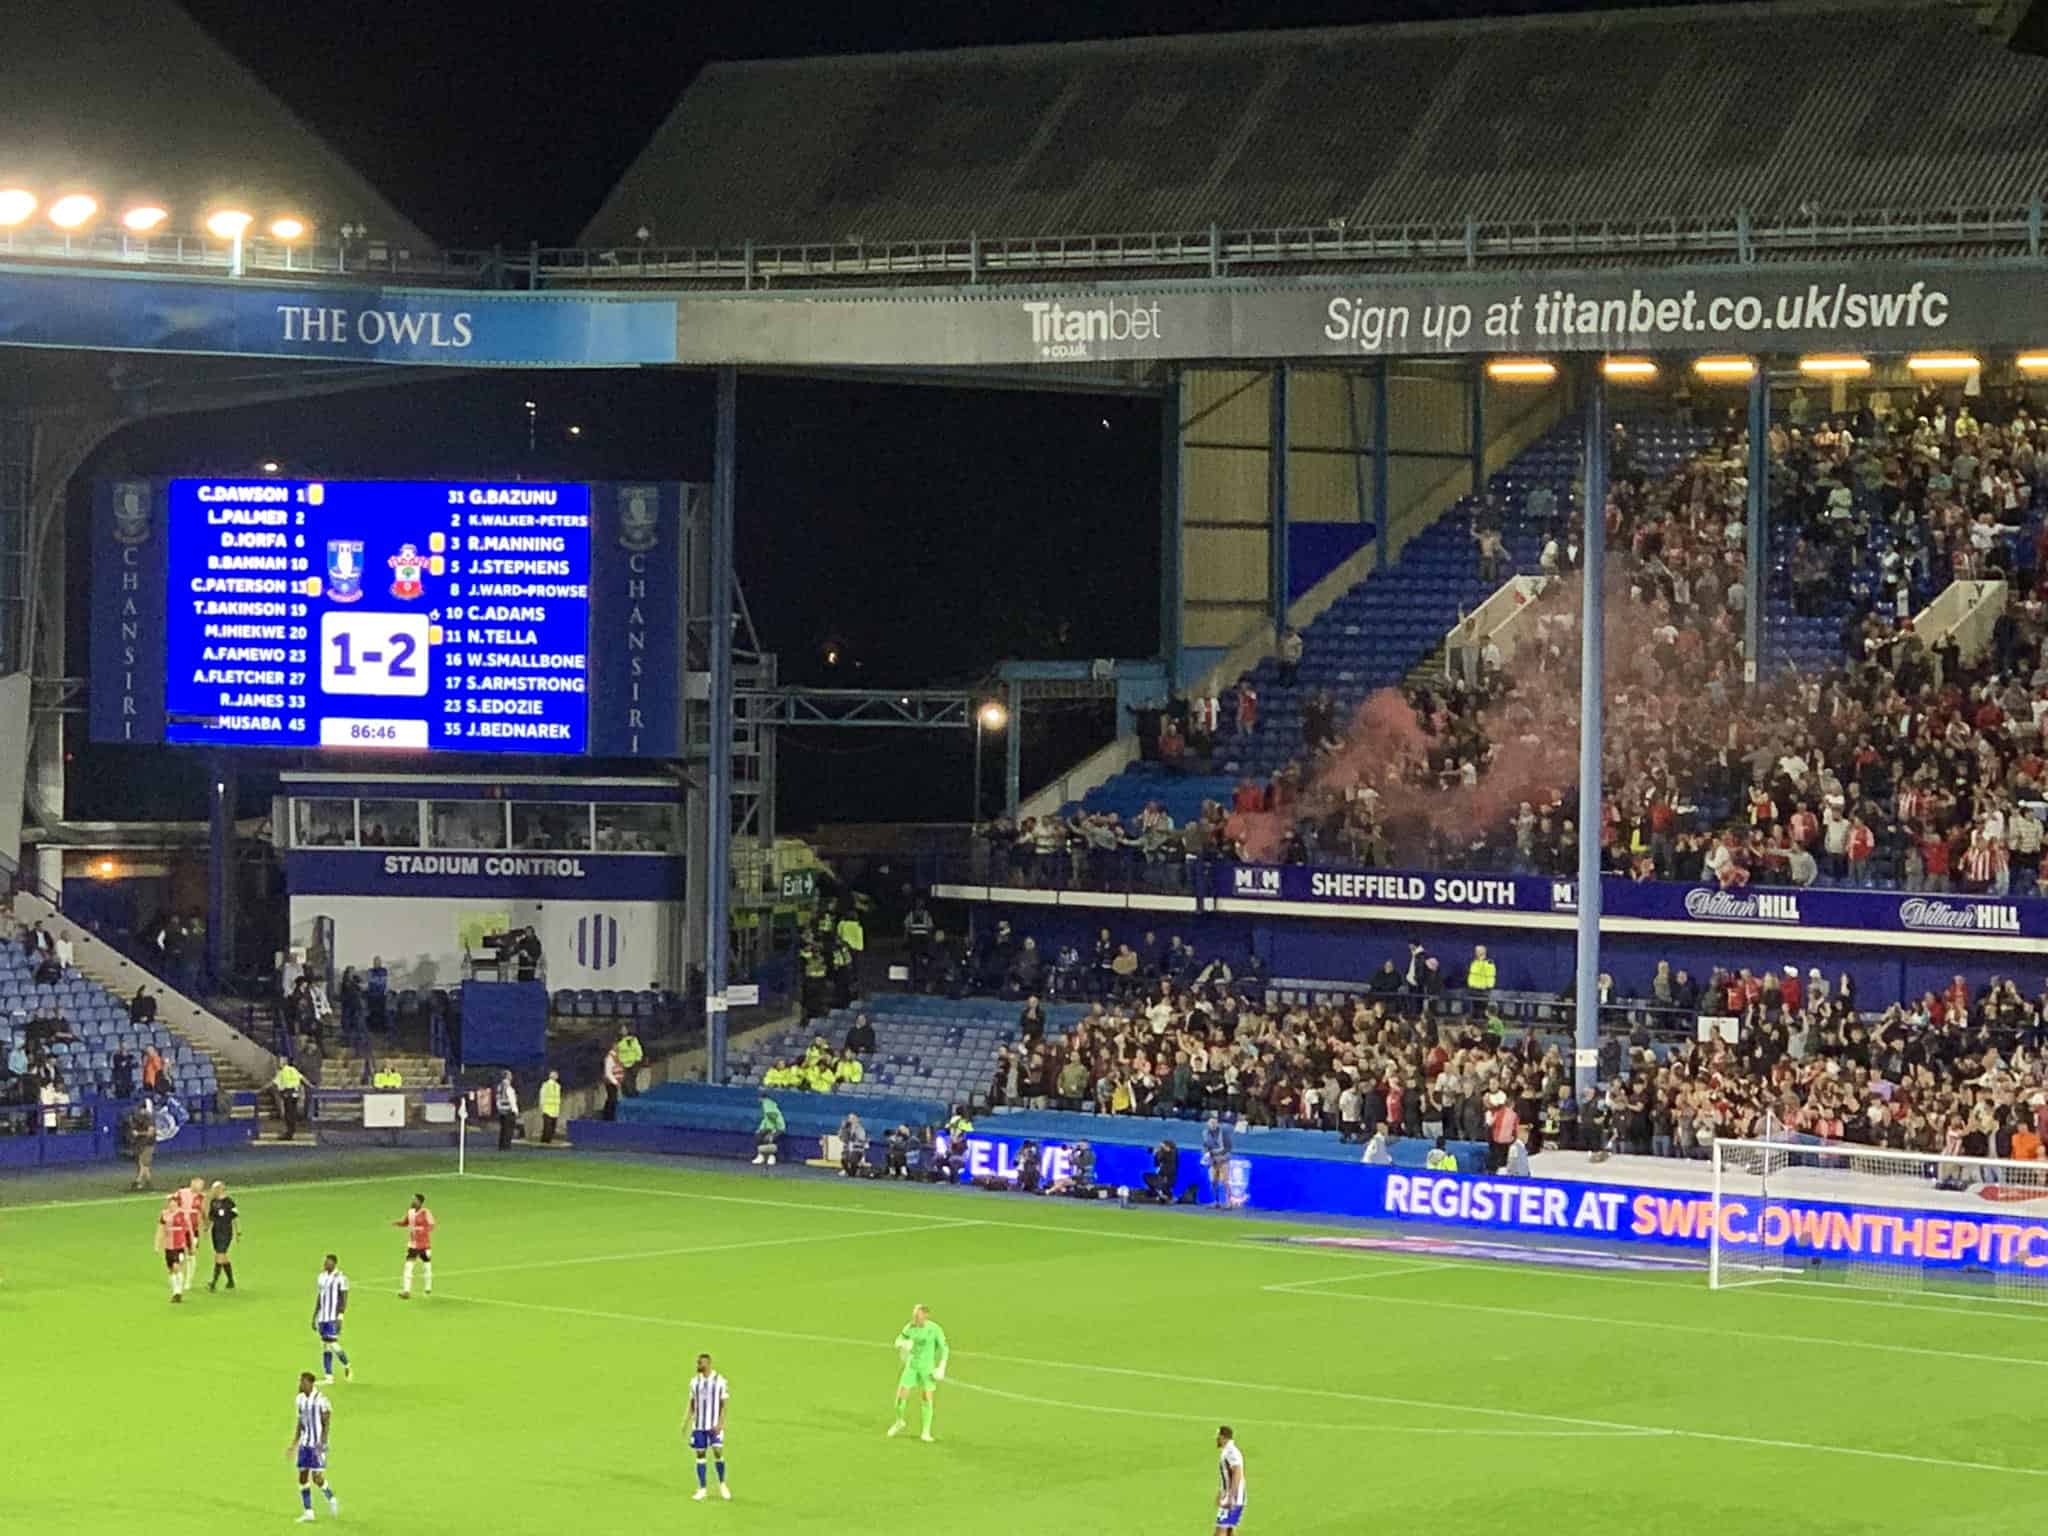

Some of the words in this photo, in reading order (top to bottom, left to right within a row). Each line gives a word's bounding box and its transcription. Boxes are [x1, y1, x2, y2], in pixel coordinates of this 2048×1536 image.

[1023, 300, 1162, 343] Titanbet
[1324, 297, 1411, 350] Sign
[1421, 301, 1472, 341] up
[1484, 297, 1524, 337] at
[1534, 282, 1950, 335] titanbet.co.uk/swfc
[277, 305, 347, 342] THE
[357, 310, 472, 348] OWLS
[198, 486, 288, 502] C.DAWSON
[296, 489, 304, 502] 1
[448, 490, 464, 503] 31
[469, 489, 557, 505] G.BAZUNU
[208, 509, 288, 525] L.PALMER
[296, 512, 304, 524] 2
[451, 514, 460, 526] 2
[469, 515, 587, 527] K.WALKER-PETERS
[451, 536, 460, 550] 3
[468, 536, 564, 552] R.MANNING
[291, 558, 308, 570] 10
[451, 560, 460, 573] 5
[469, 560, 569, 575] J.STEPHENS
[191, 578, 286, 593] C.PATERSON
[469, 584, 587, 598] J.WARD-PROWSE
[194, 601, 286, 616] T.BAKINSON
[291, 604, 307, 616] 19
[447, 607, 463, 619] 10
[468, 606, 545, 621] C.ADAMS
[290, 627, 307, 639] 20
[446, 630, 461, 642] 11
[468, 629, 537, 644] N.TELLA
[122, 546, 139, 741] CHANSIRI
[203, 647, 285, 662] A.FAMEWO
[331, 631, 417, 677] 1-2
[446, 653, 462, 666] 16
[467, 653, 585, 668] W.SMALLBONE
[627, 552, 646, 754] CHANSIRI
[194, 670, 284, 684] A.FLETCHER
[290, 672, 305, 685] 27
[446, 677, 461, 688] 17
[467, 676, 585, 692] S.ARMSTRONG
[221, 693, 284, 707] R.JAMES
[445, 700, 461, 712] 23
[467, 699, 543, 714] S.EDOZIE
[203, 716, 282, 730] .MUSABA
[290, 719, 305, 731] 45
[445, 723, 461, 735] 35
[467, 723, 570, 738] J.BEDNAREK
[351, 724, 397, 739] 86:46
[384, 855, 479, 876] STADIUM
[485, 857, 585, 879] CONTROL
[783, 875, 804, 896] Exit
[1311, 872, 1426, 901] SHEFFIELD
[1433, 878, 1516, 905] SOUTH
[1685, 887, 1758, 919] William
[1757, 894, 1800, 920] HILL
[1899, 897, 1976, 929] William
[1976, 903, 2020, 930] HILL
[1384, 1173, 1568, 1228] REGISTER
[1573, 1190, 1627, 1230] AT
